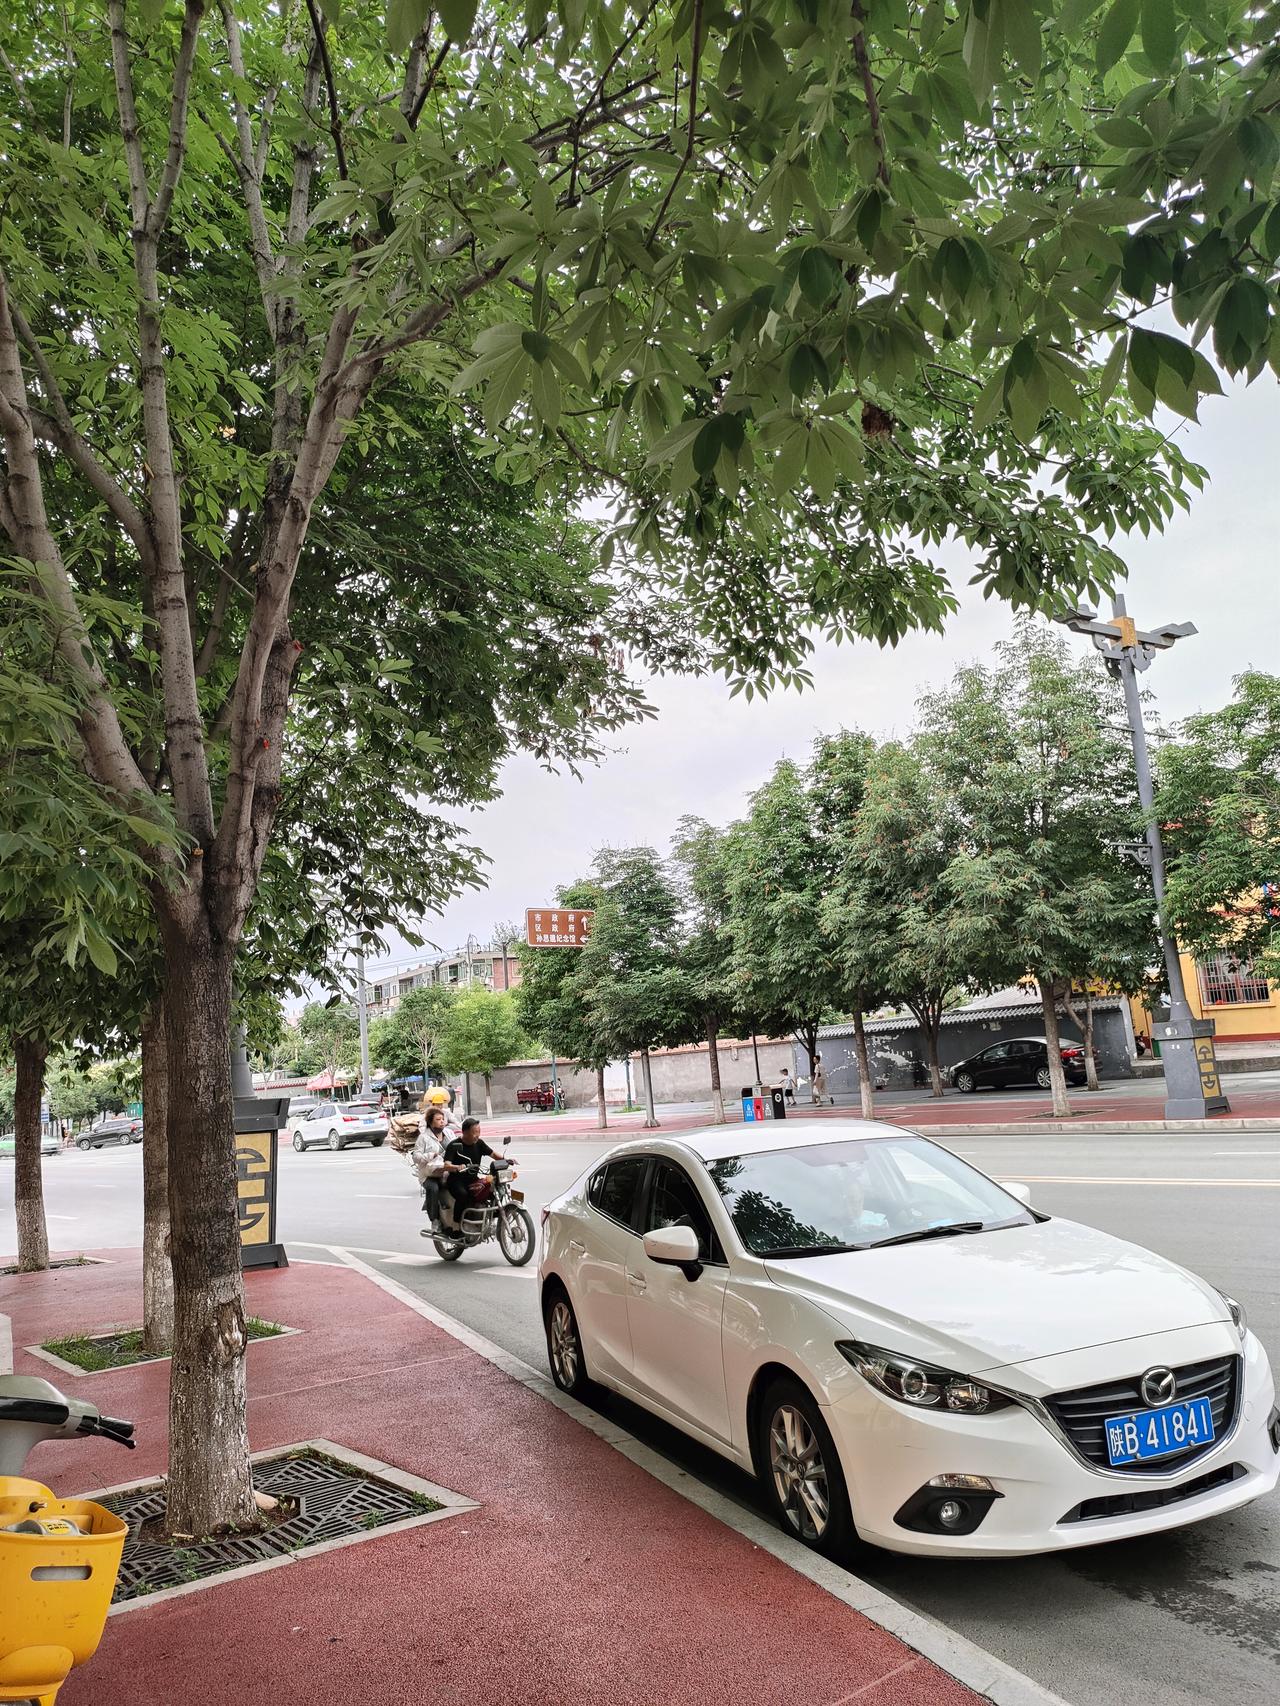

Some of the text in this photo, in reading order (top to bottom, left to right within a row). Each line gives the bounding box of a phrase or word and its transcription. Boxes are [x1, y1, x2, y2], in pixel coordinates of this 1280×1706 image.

[535, 913, 575, 922] 市政府
[534, 924, 575, 932] 区政府
